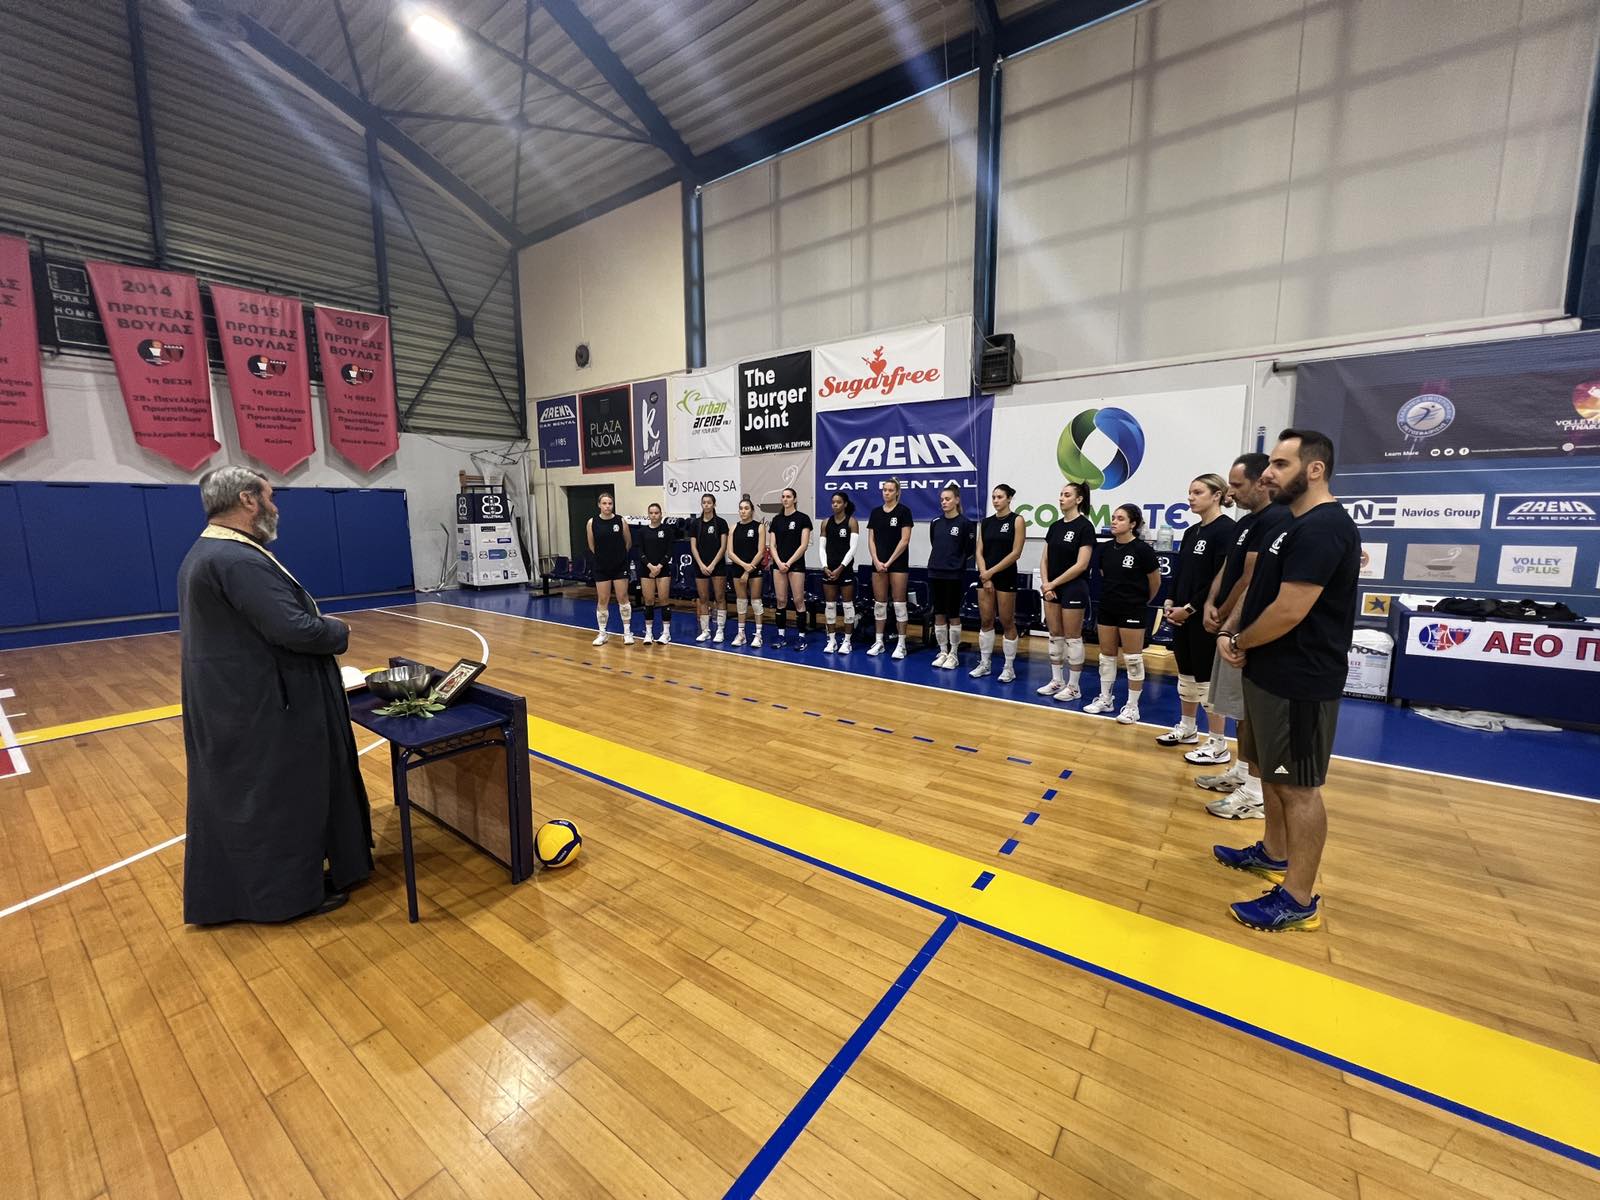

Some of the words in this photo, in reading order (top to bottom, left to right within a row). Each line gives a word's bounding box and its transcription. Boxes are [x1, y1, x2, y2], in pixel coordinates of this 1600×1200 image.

[121, 280, 173, 297] 2014
[54, 306, 96, 319] HOME
[107, 302, 195, 320] ΠΡΩΤΕΑΣ
[238, 302, 280, 318] 2015
[117, 318, 195, 335] ΒΟΥΛΑΣ
[225, 320, 298, 340] ΠΡΩΤΕΑΣ
[335, 316, 370, 331] 2016
[232, 336, 297, 352] ΒΟΥΛΑΣ
[324, 332, 385, 350] ΠΡΩΤΕΑΣ
[329, 345, 382, 361] ΒΟΥΛΑΣ
[744, 368, 776, 387] The
[818, 366, 941, 399] Sugarfree
[747, 387, 808, 411] Burger
[540, 404, 576, 423] ARENA
[696, 401, 727, 416] urban
[590, 420, 622, 435] PLAZA
[693, 415, 724, 428] arena
[744, 410, 789, 431] Joint
[590, 434, 623, 448] NUOVA
[825, 433, 977, 476] ARENA
[682, 480, 720, 493] SPANOS
[723, 480, 737, 492] SA
[824, 481, 868, 491] CAR
[1353, 504, 1374, 520] N
[1401, 508, 1440, 517] Navios
[1443, 508, 1481, 519] Group
[1508, 501, 1597, 515] ARENA
[1512, 557, 1562, 566] VOLLEY
[1526, 566, 1561, 575] PLUS
